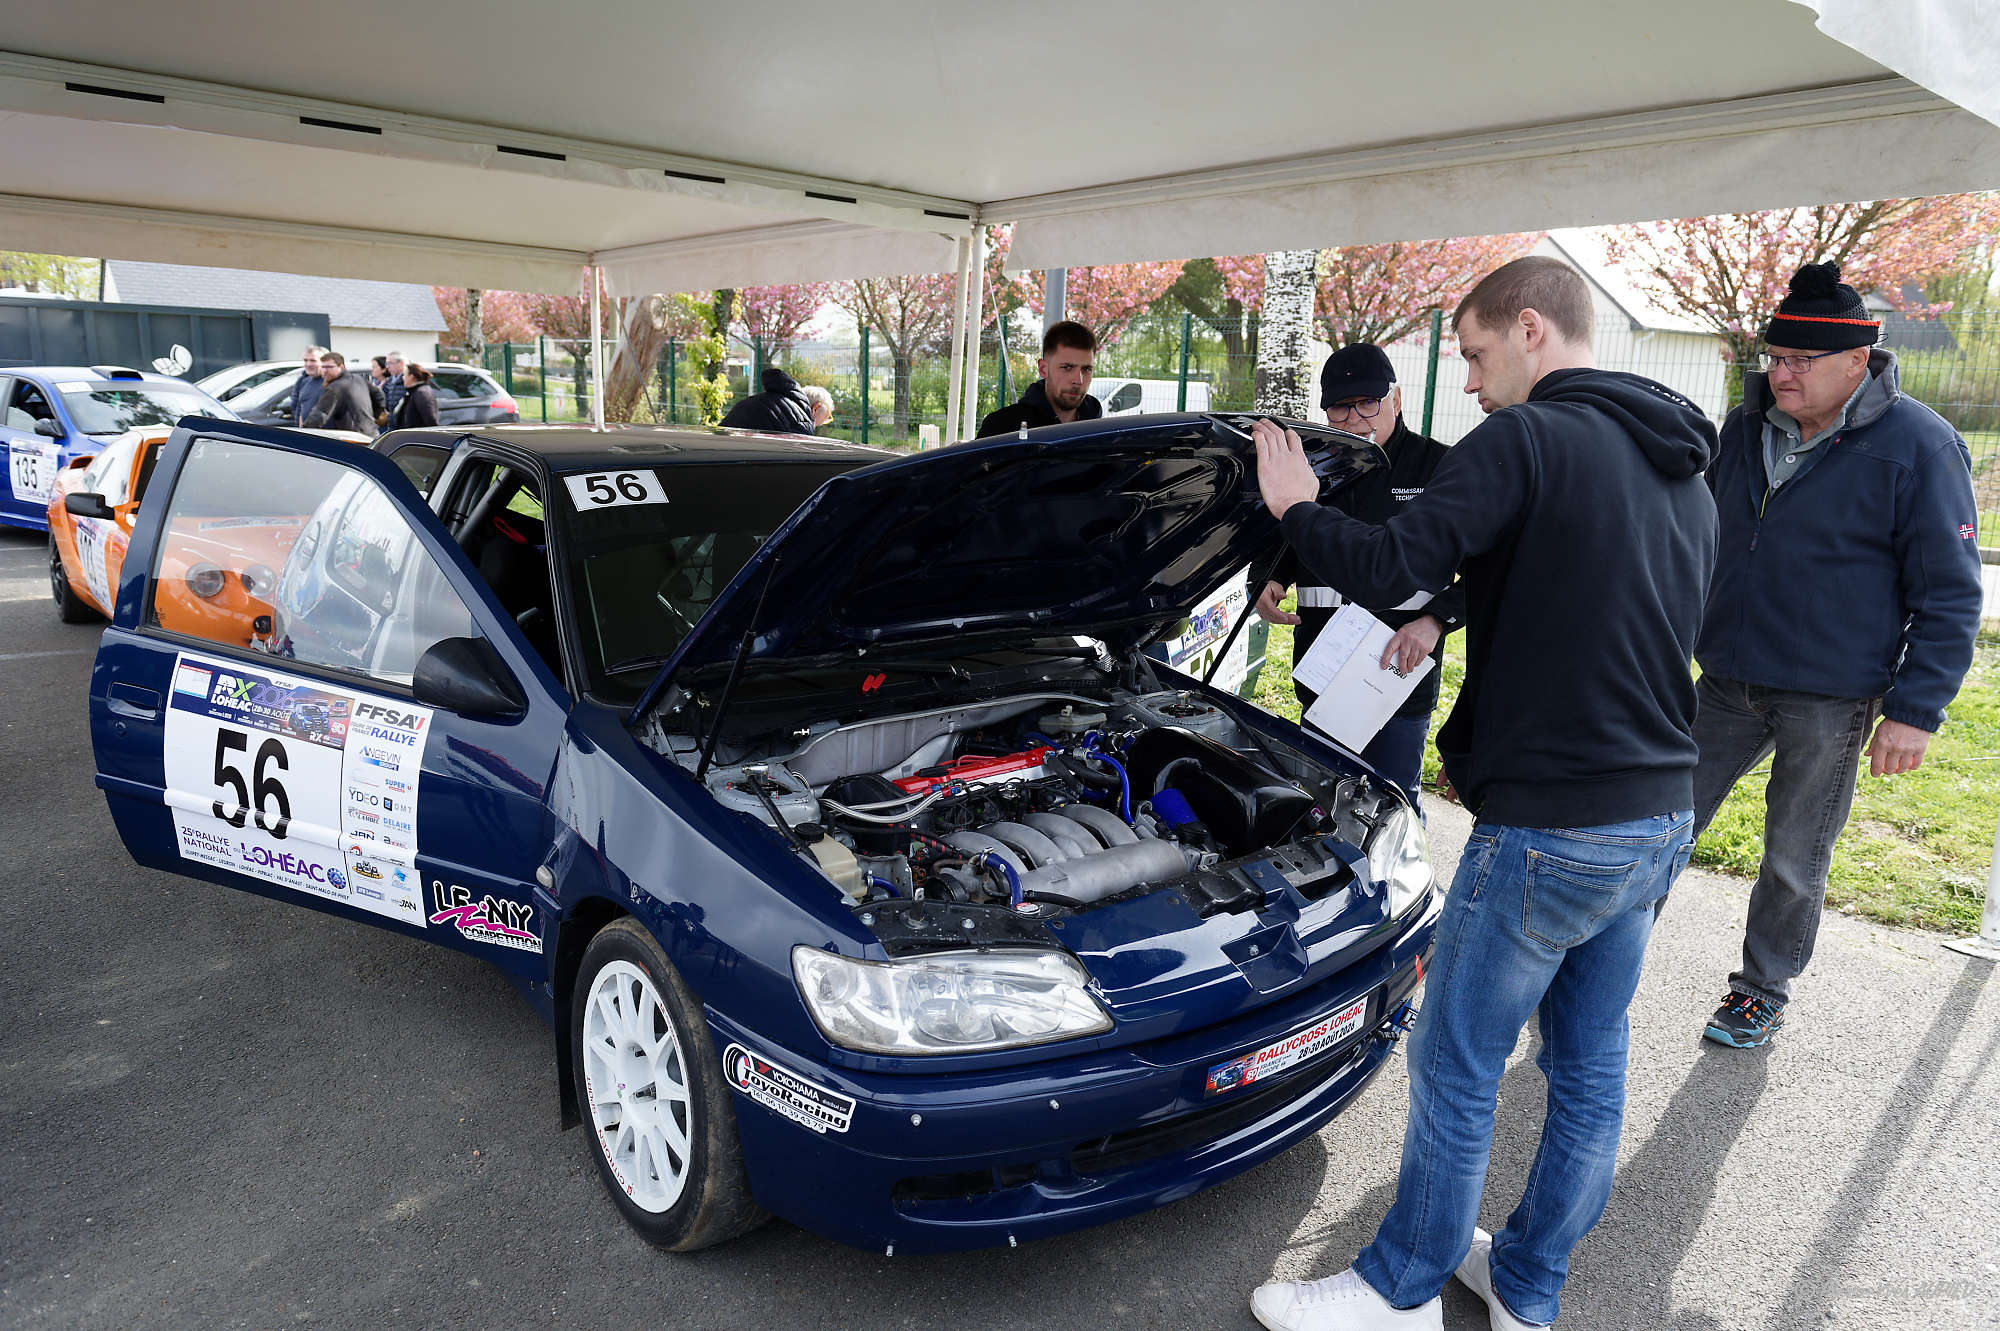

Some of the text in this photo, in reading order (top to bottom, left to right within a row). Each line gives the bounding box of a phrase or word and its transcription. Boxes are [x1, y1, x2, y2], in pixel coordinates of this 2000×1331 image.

[16, 456, 37, 489] 135
[586, 473, 647, 504] 56
[1225, 590, 1242, 606] FFSA
[213, 674, 257, 701] RX
[211, 693, 252, 712] LOHEAC
[355, 702, 415, 730] FFSA
[370, 727, 417, 747] RALLYE
[359, 745, 401, 764] ANGEVIN
[212, 727, 291, 840] 56
[385, 778, 406, 789] SUPER
[383, 817, 411, 831] DELAIRE
[195, 829, 230, 847] RALLYE
[350, 830, 375, 841] JAN
[183, 836, 232, 857] NATIONAL
[240, 842, 326, 883] LOHÉAC
[399, 899, 417, 912] JAN
[1338, 1020, 1356, 1039] 2026
[1256, 1023, 1328, 1064] RALLYCROSS
[1257, 1065, 1280, 1077] EUROPE
[1259, 1057, 1282, 1071] FRANCE
[772, 1070, 820, 1102] YOKOHAMA
[743, 1067, 848, 1129] ToyoRacing
[766, 1096, 776, 1107] 06
[777, 1102, 787, 1113] 10
[789, 1109, 799, 1119] 39
[800, 1115, 811, 1126] 43
[813, 1120, 824, 1131] 79
